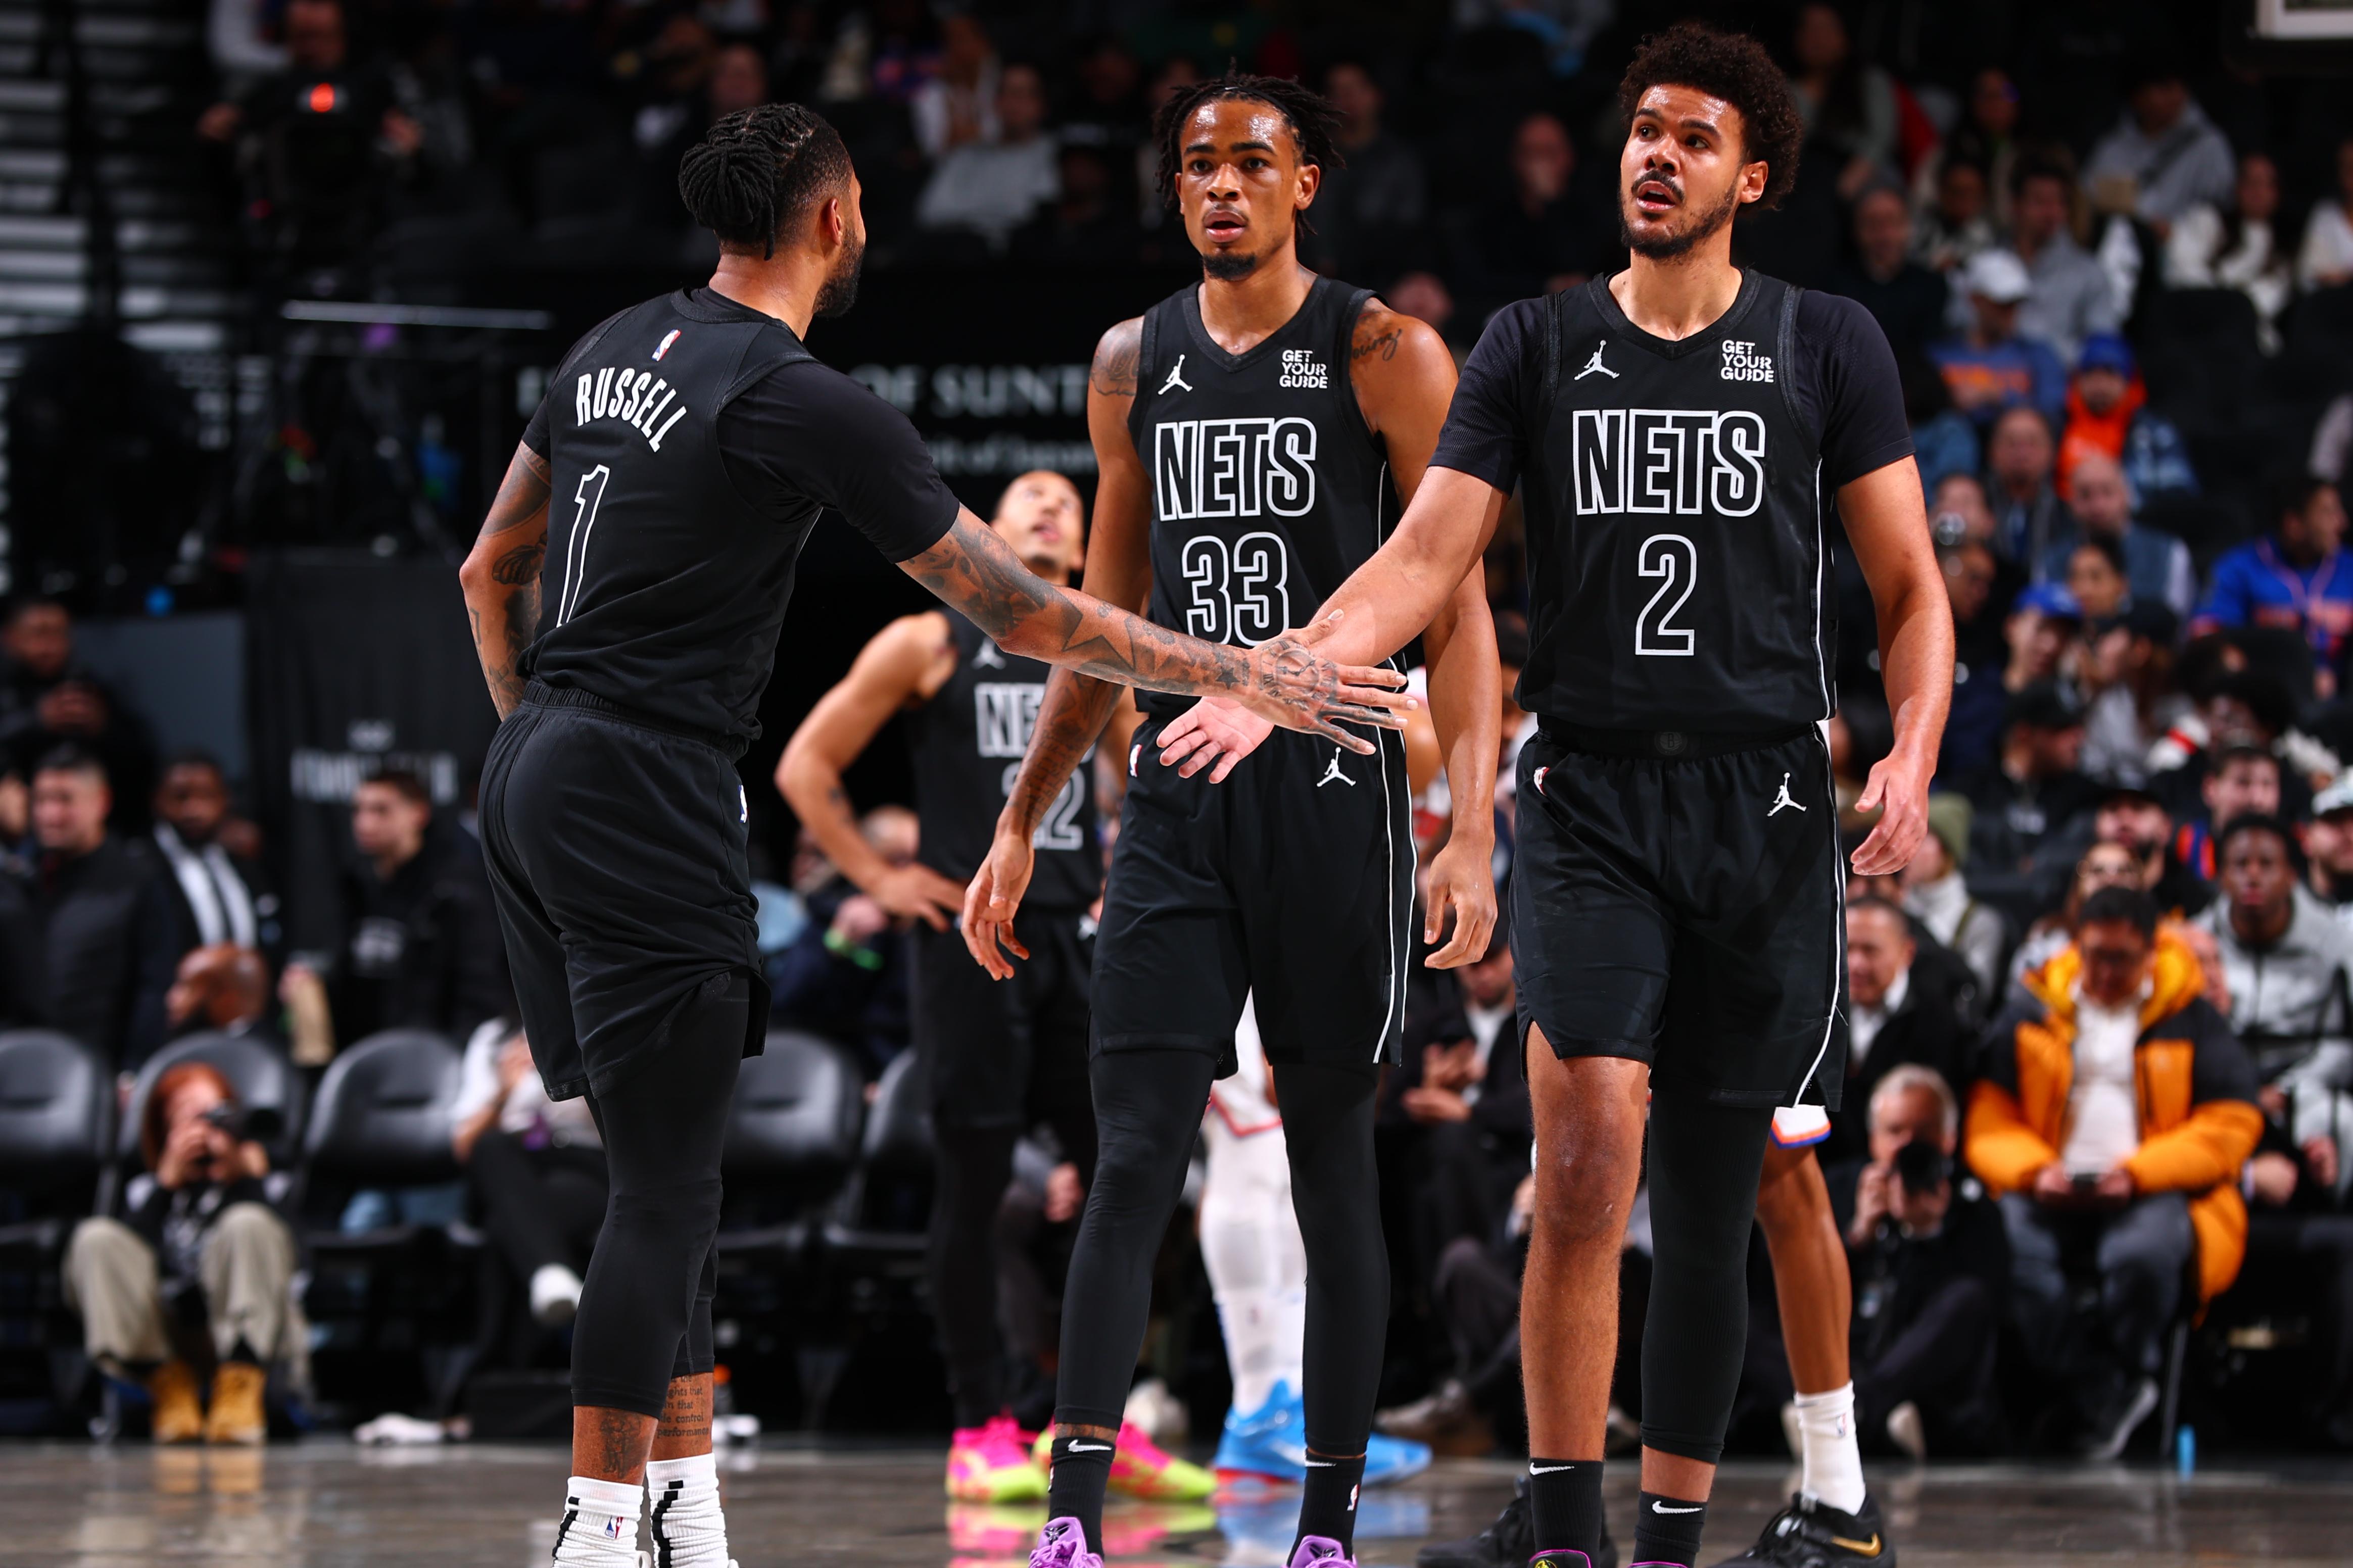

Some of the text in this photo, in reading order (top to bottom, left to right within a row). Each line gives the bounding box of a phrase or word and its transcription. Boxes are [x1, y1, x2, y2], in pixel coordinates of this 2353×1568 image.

[1722, 339, 1755, 355] GET
[1282, 350, 1313, 362] GET
[1722, 353, 1772, 369] YOUR
[1281, 362, 1327, 376] YOUR
[1720, 367, 1774, 383] GUIDE
[1279, 375, 1328, 388] GUIDE
[576, 367, 687, 453] RUSSELL
[1156, 418, 1316, 521] NETS
[1572, 409, 1765, 517] NETS
[557, 464, 610, 628] 1
[1182, 532, 1288, 647] 33
[1635, 534, 1697, 657] 2
[676, 1412, 704, 1423] control
